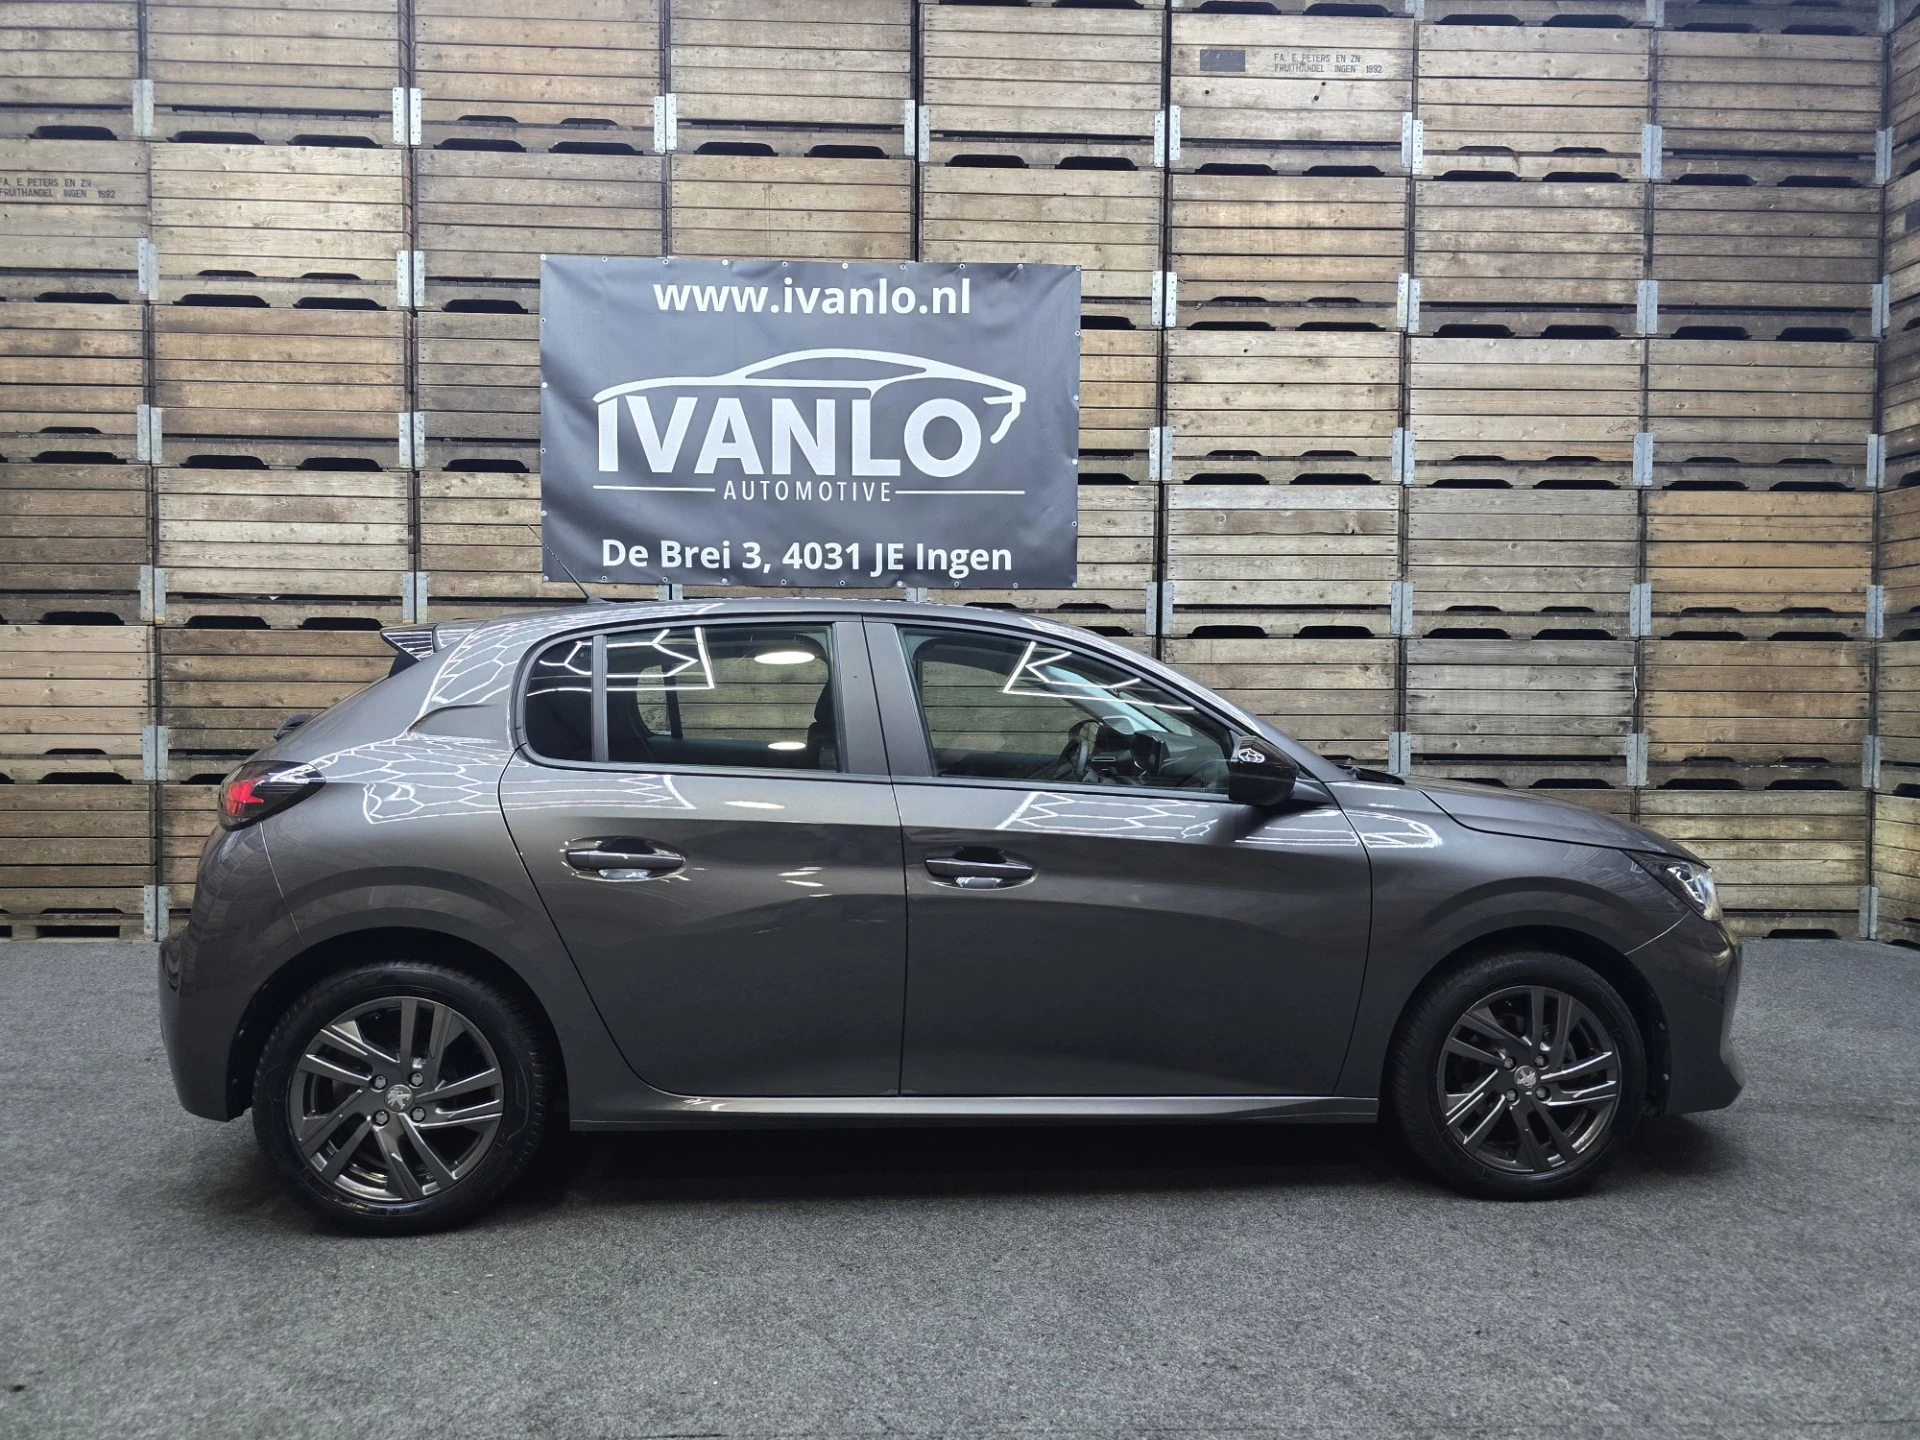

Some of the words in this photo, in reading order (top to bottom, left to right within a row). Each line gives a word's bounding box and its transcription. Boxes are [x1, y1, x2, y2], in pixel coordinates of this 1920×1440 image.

[1302, 54, 1331, 63] PETERS
[1335, 54, 1346, 63] EN
[1350, 54, 1361, 63] ZN
[1274, 63, 1325, 73] FRUITHANDEL
[1334, 64, 1356, 73] INGEN
[1366, 65, 1383, 74] 1992
[27, 177, 59, 187] PETERS
[64, 178, 76, 187] EN
[80, 179, 91, 188] ZN
[0, 187, 53, 198] FRUITHANDEL
[63, 189, 87, 198] INGEN
[97, 190, 116, 199] 1992
[653, 277, 971, 315] www.ivanlo.nl
[597, 394, 982, 478] IVANLO
[723, 480, 892, 502] AUTOMOTIVE
[602, 539, 649, 568] De
[660, 540, 731, 569] Brei
[742, 541, 772, 574] 3,
[781, 542, 859, 570] 4031
[870, 542, 904, 578] JE
[916, 542, 1012, 579] Ingen
